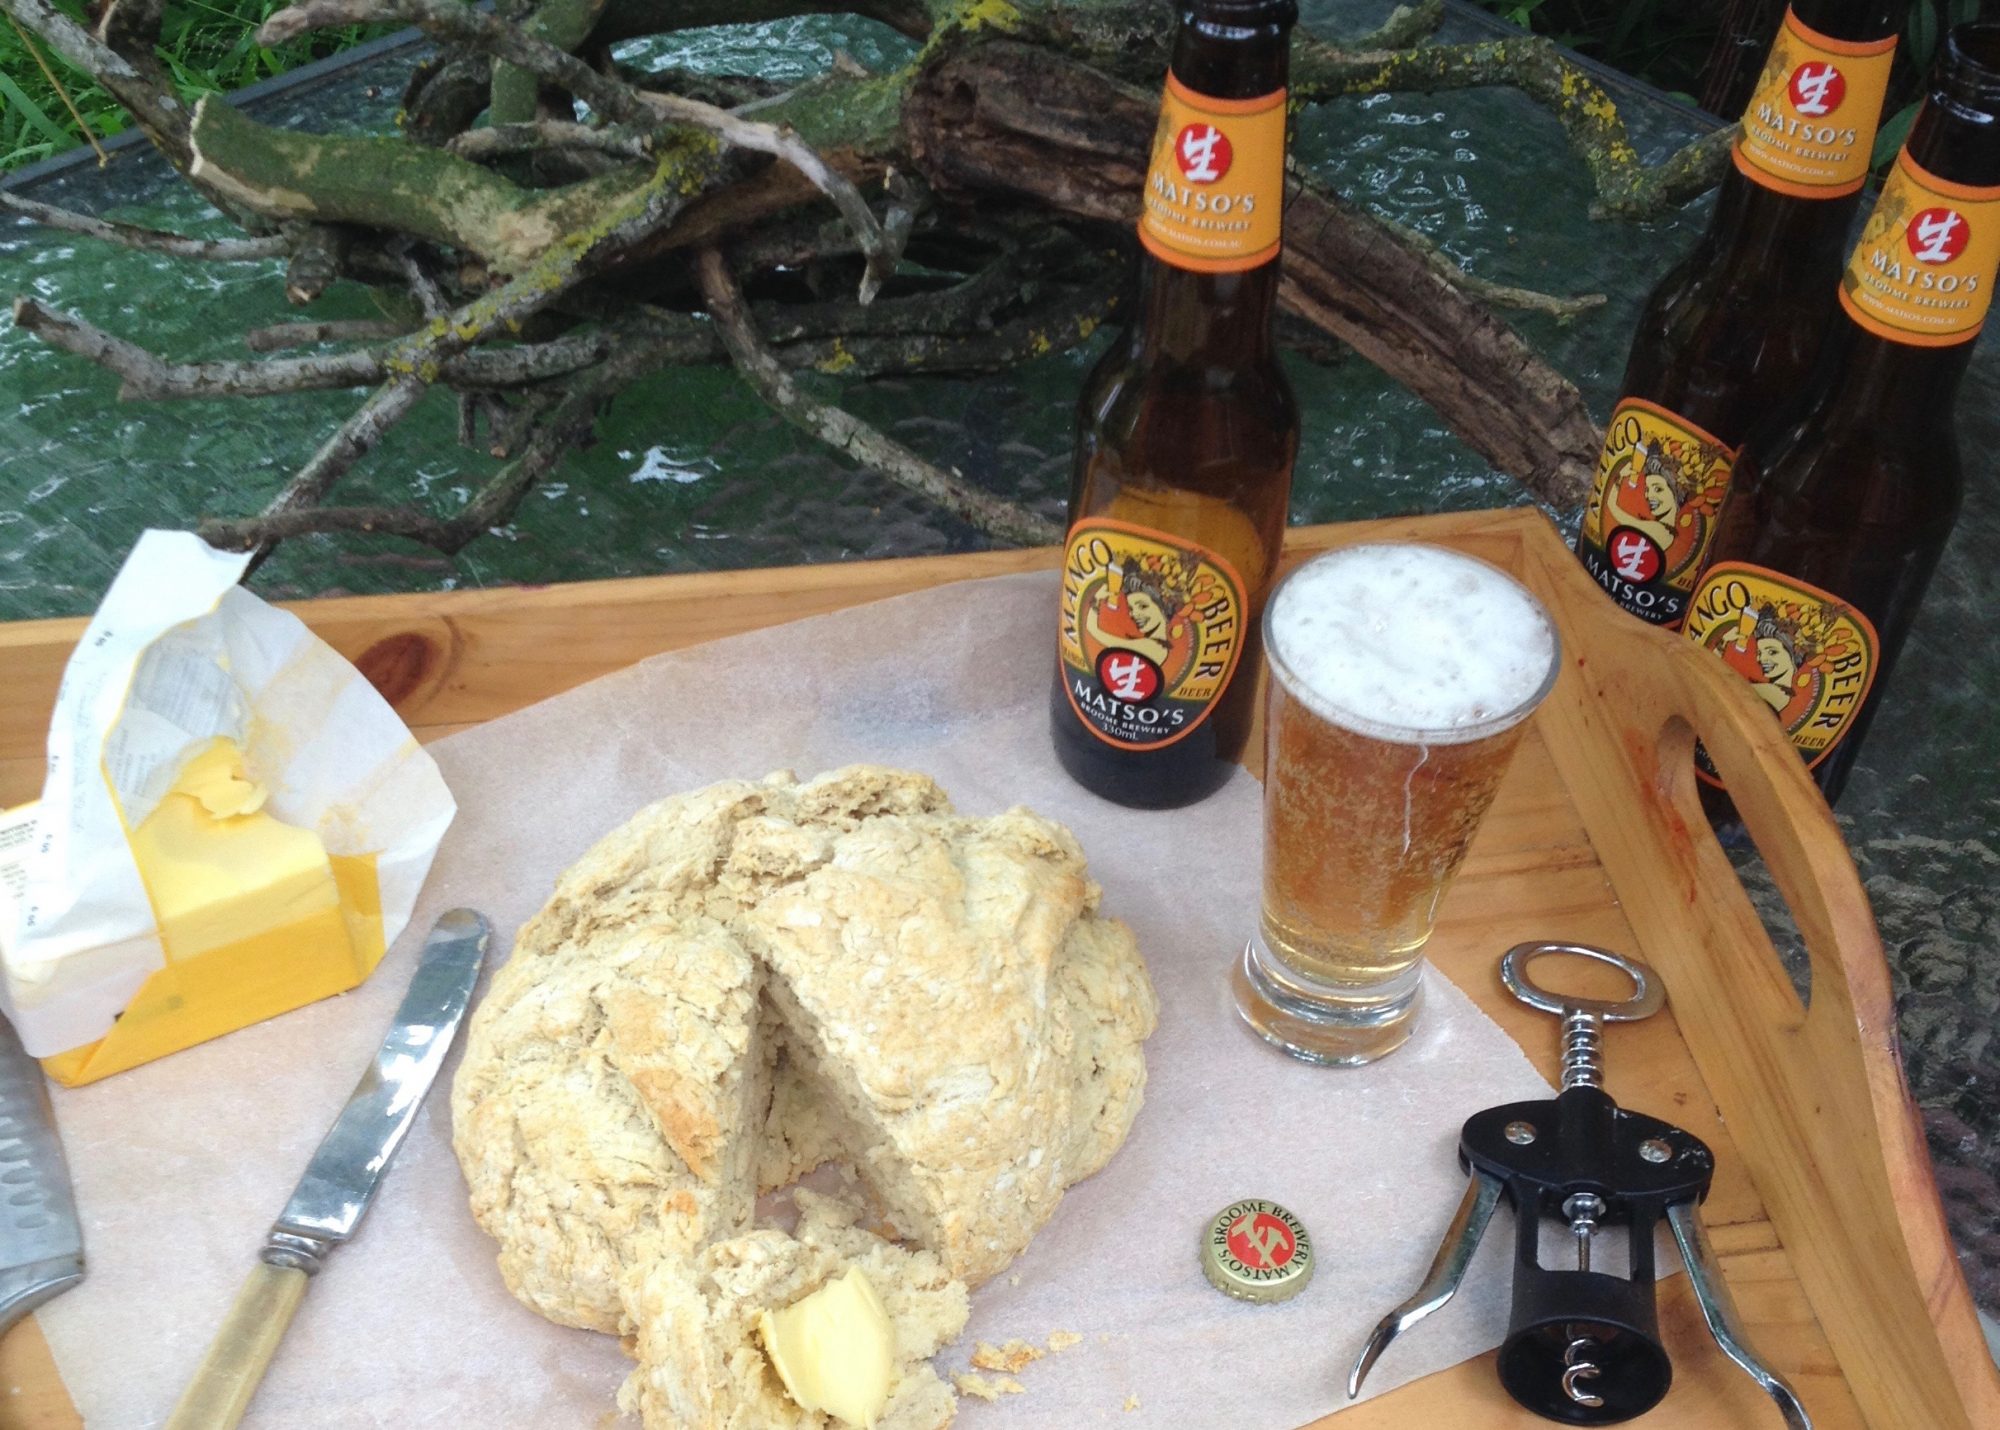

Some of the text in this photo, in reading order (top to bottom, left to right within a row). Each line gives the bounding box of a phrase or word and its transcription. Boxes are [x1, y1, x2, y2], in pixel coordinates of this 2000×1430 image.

[1757, 103, 1856, 148] MATSO'S
[1152, 171, 1255, 214] MATSO'S
[1871, 249, 1979, 293] MATSO'S
[1063, 538, 1113, 645] MANGO
[1585, 553, 1679, 614] MATSO'S
[1689, 581, 1751, 641] ANGO
[1194, 595, 1232, 681] BEER
[1075, 679, 1185, 725] MATSO'S
[1080, 701, 1170, 735] BROOME BREWERY
[1811, 652, 1861, 729] BEER
[1213, 1202, 1309, 1281] BROOME BREWERY MATSO'S
